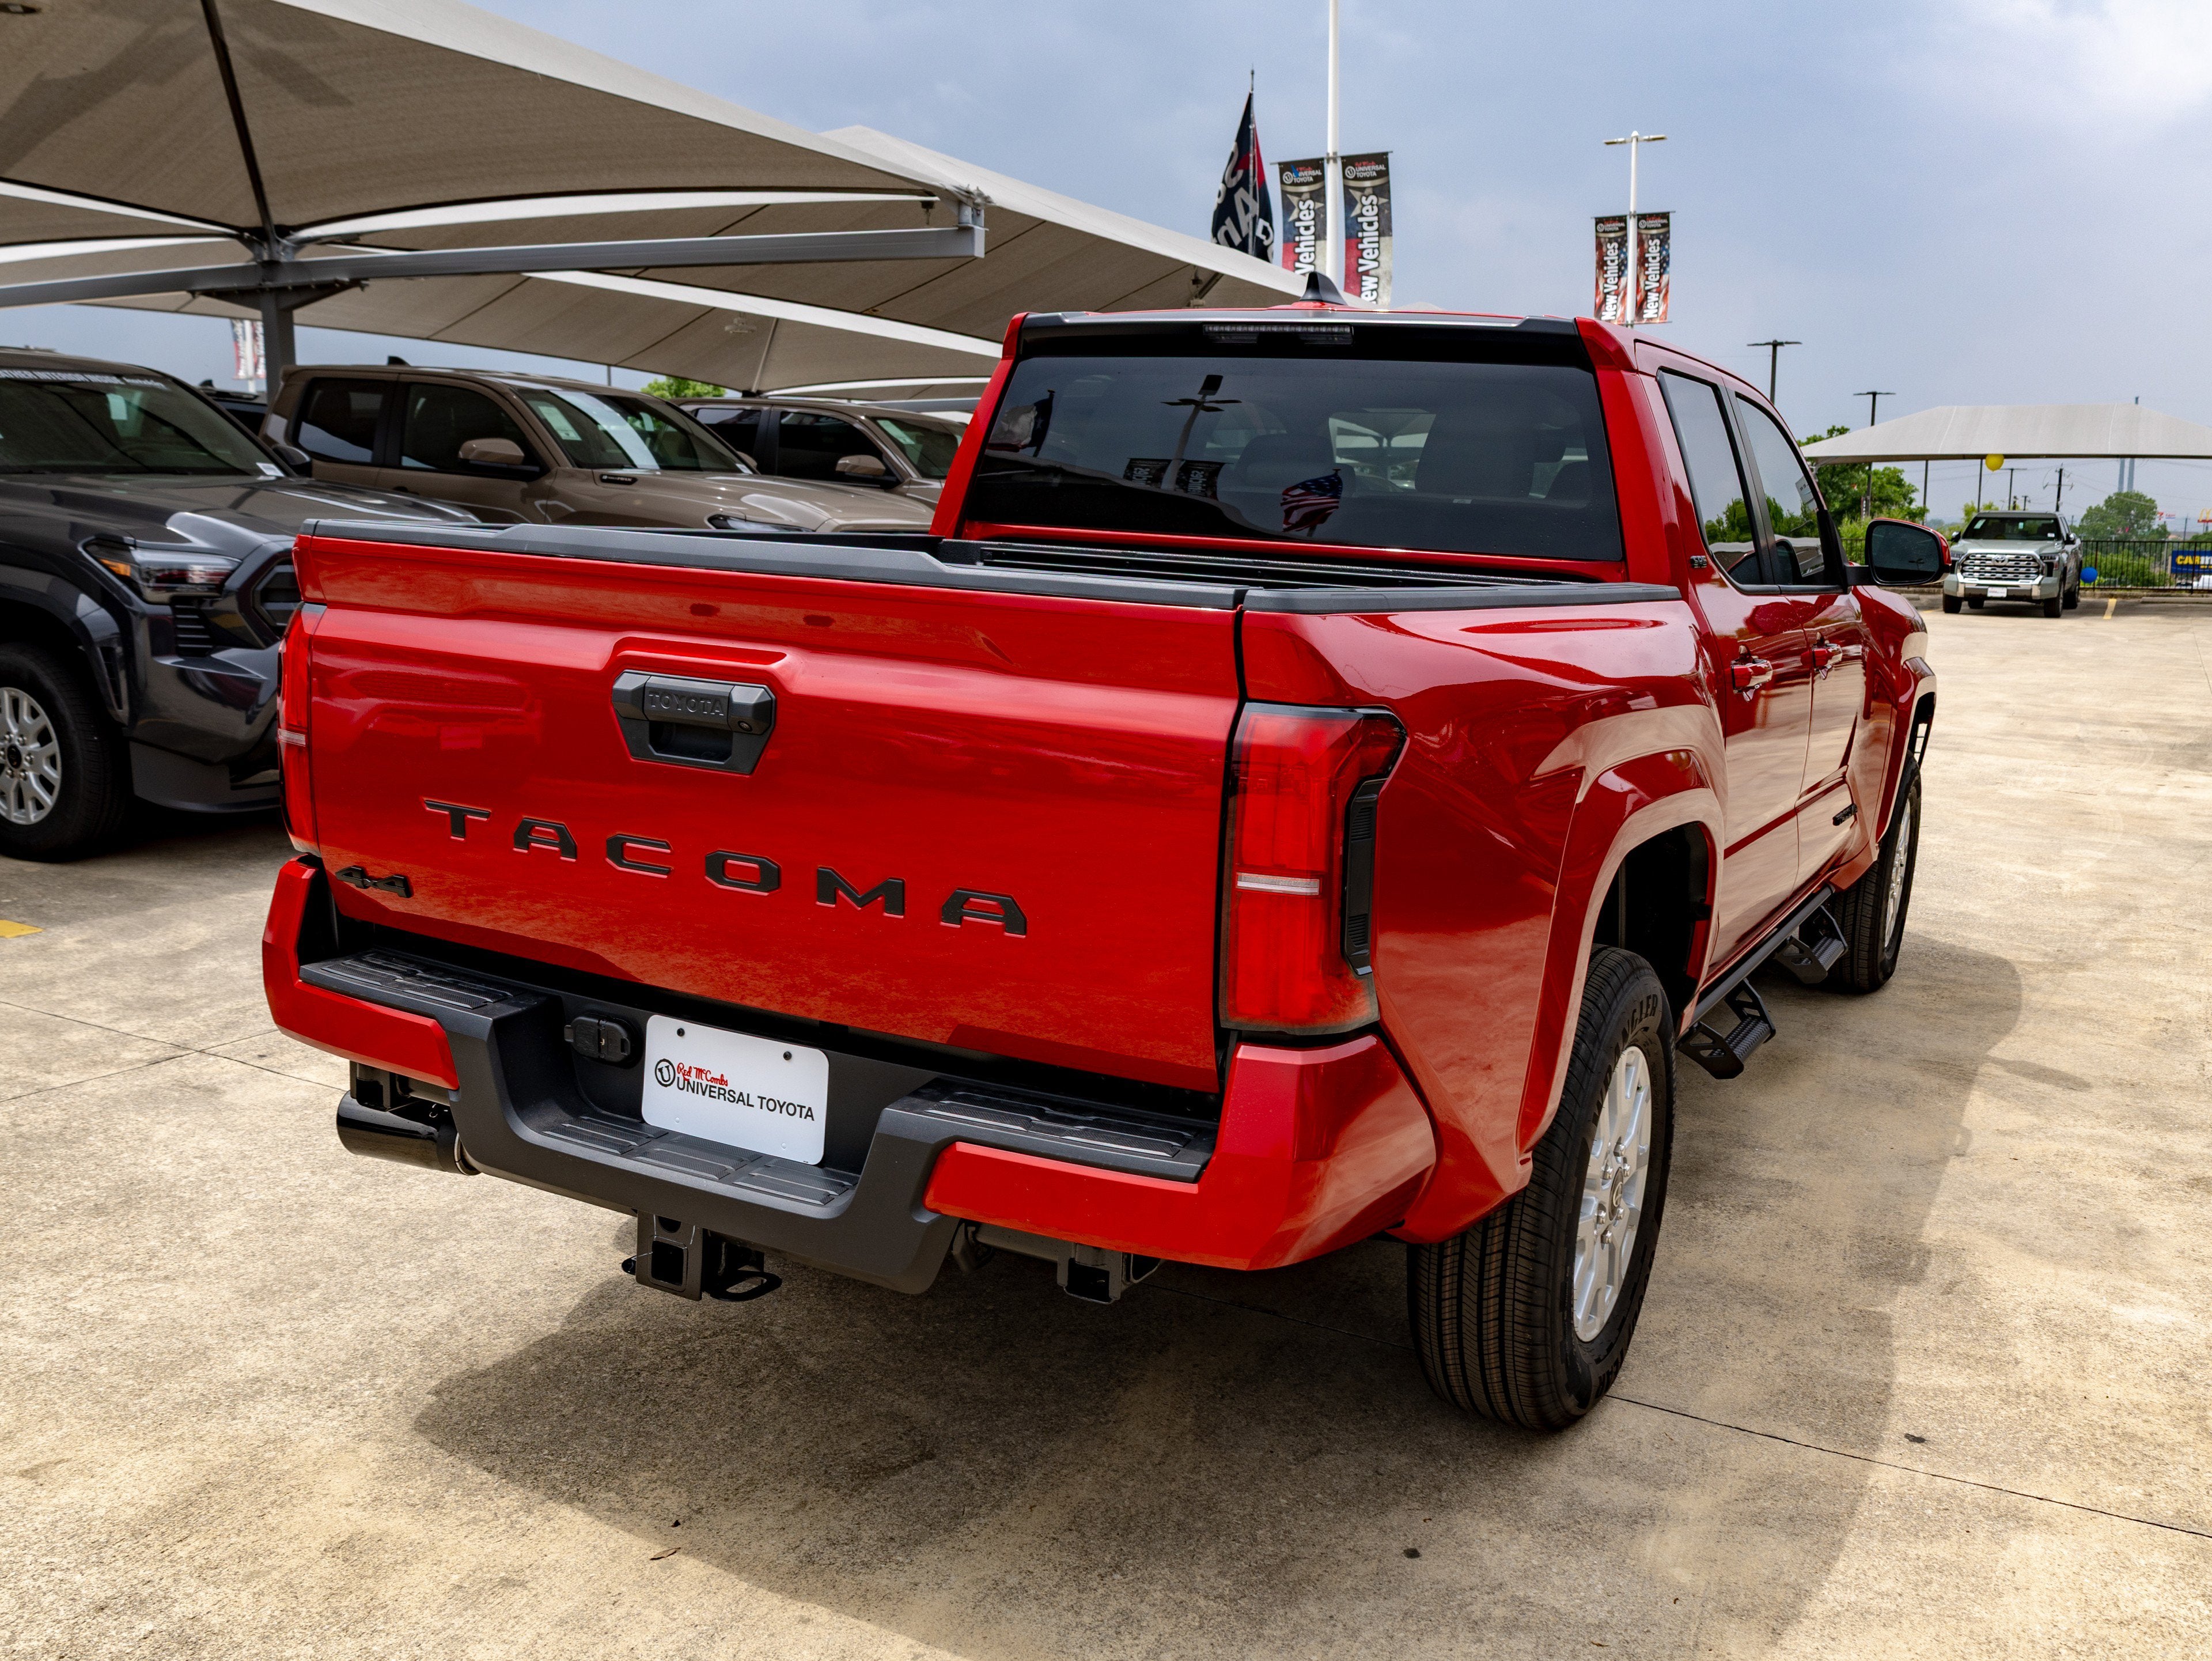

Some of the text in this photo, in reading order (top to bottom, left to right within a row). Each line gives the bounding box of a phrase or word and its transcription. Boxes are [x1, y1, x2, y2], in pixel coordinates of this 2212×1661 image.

[1355, 164, 1386, 172] UNIVERSAL
[1357, 194, 1380, 304] ew Vehicles
[1645, 239, 1660, 290] Vehicles
[1604, 242, 1619, 293] Vehicles
[1601, 294, 1618, 320] New
[1643, 292, 1660, 319] New
[648, 692, 724, 716] TOYOTA
[424, 799, 1027, 937] TACOMA
[677, 1062, 729, 1087] Red McCombs
[676, 1076, 815, 1122] UNIVERSAL TOYOTA
